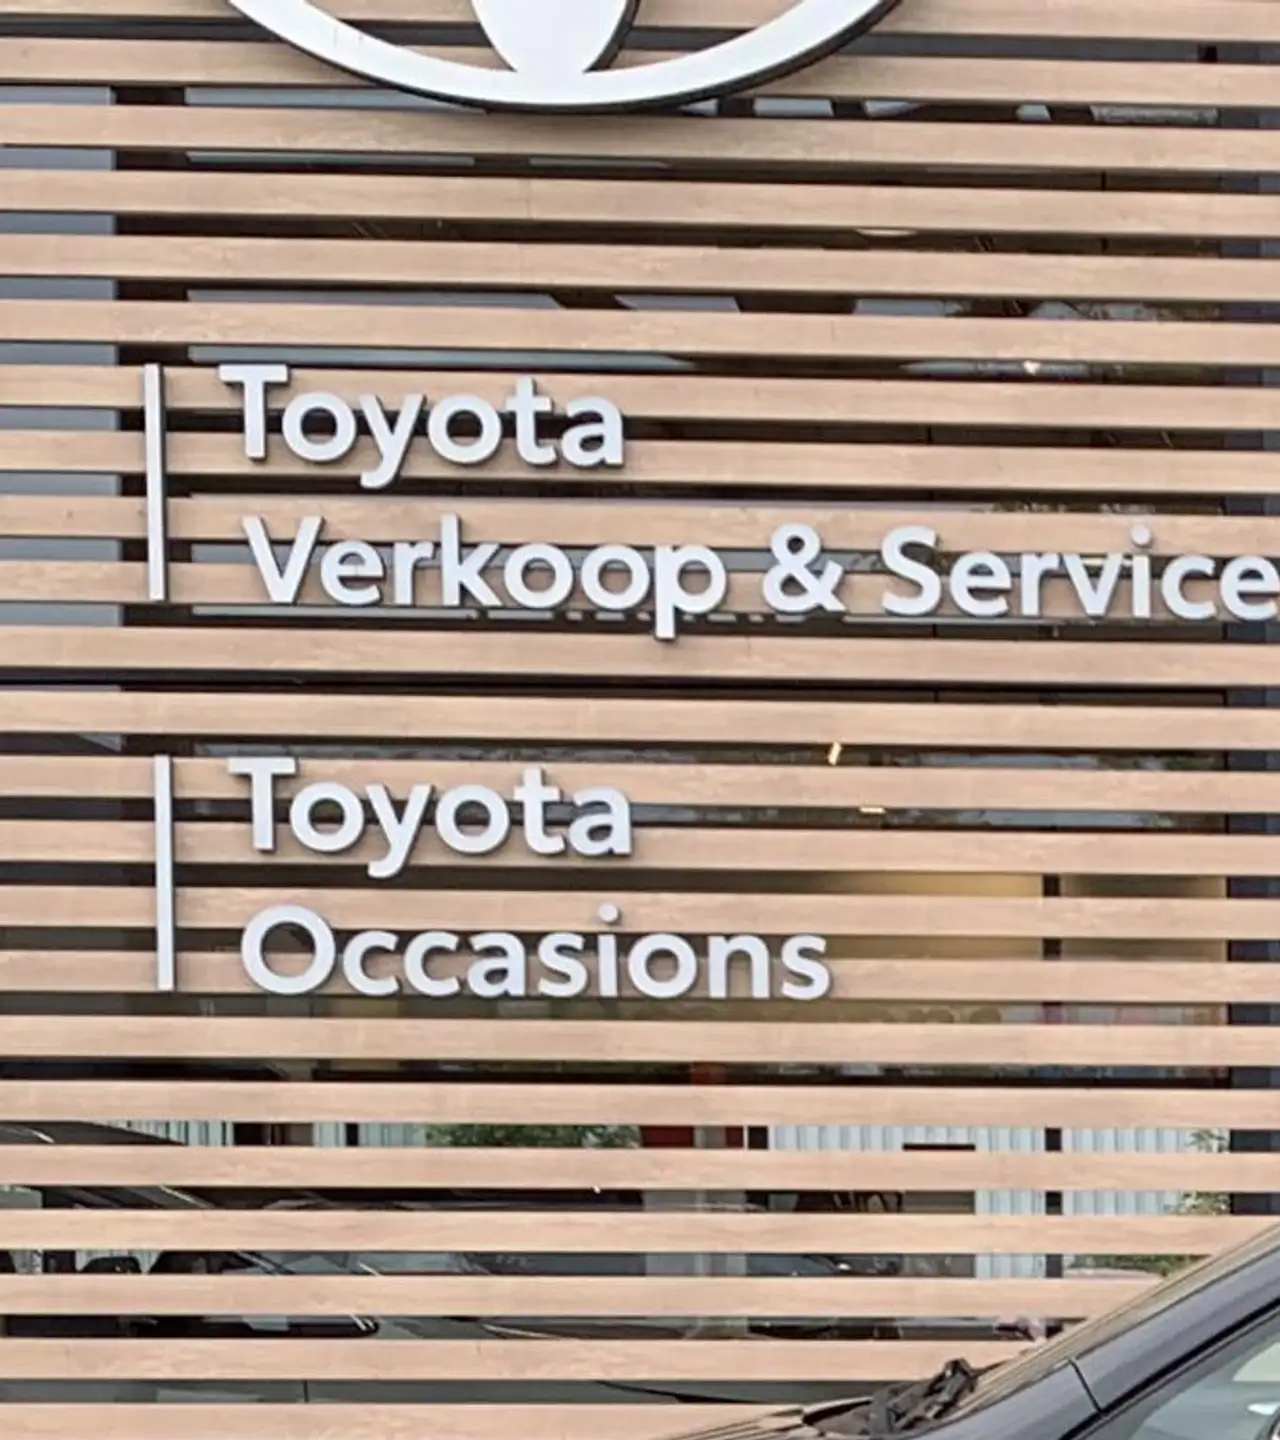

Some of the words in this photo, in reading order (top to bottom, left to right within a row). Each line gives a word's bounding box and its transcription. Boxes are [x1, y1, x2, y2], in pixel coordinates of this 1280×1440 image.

[218, 363, 625, 489] Toyota
[241, 513, 727, 640] Verkoop
[762, 523, 848, 614] &
[228, 756, 634, 879] Toyota
[240, 903, 832, 1000] Occasions
